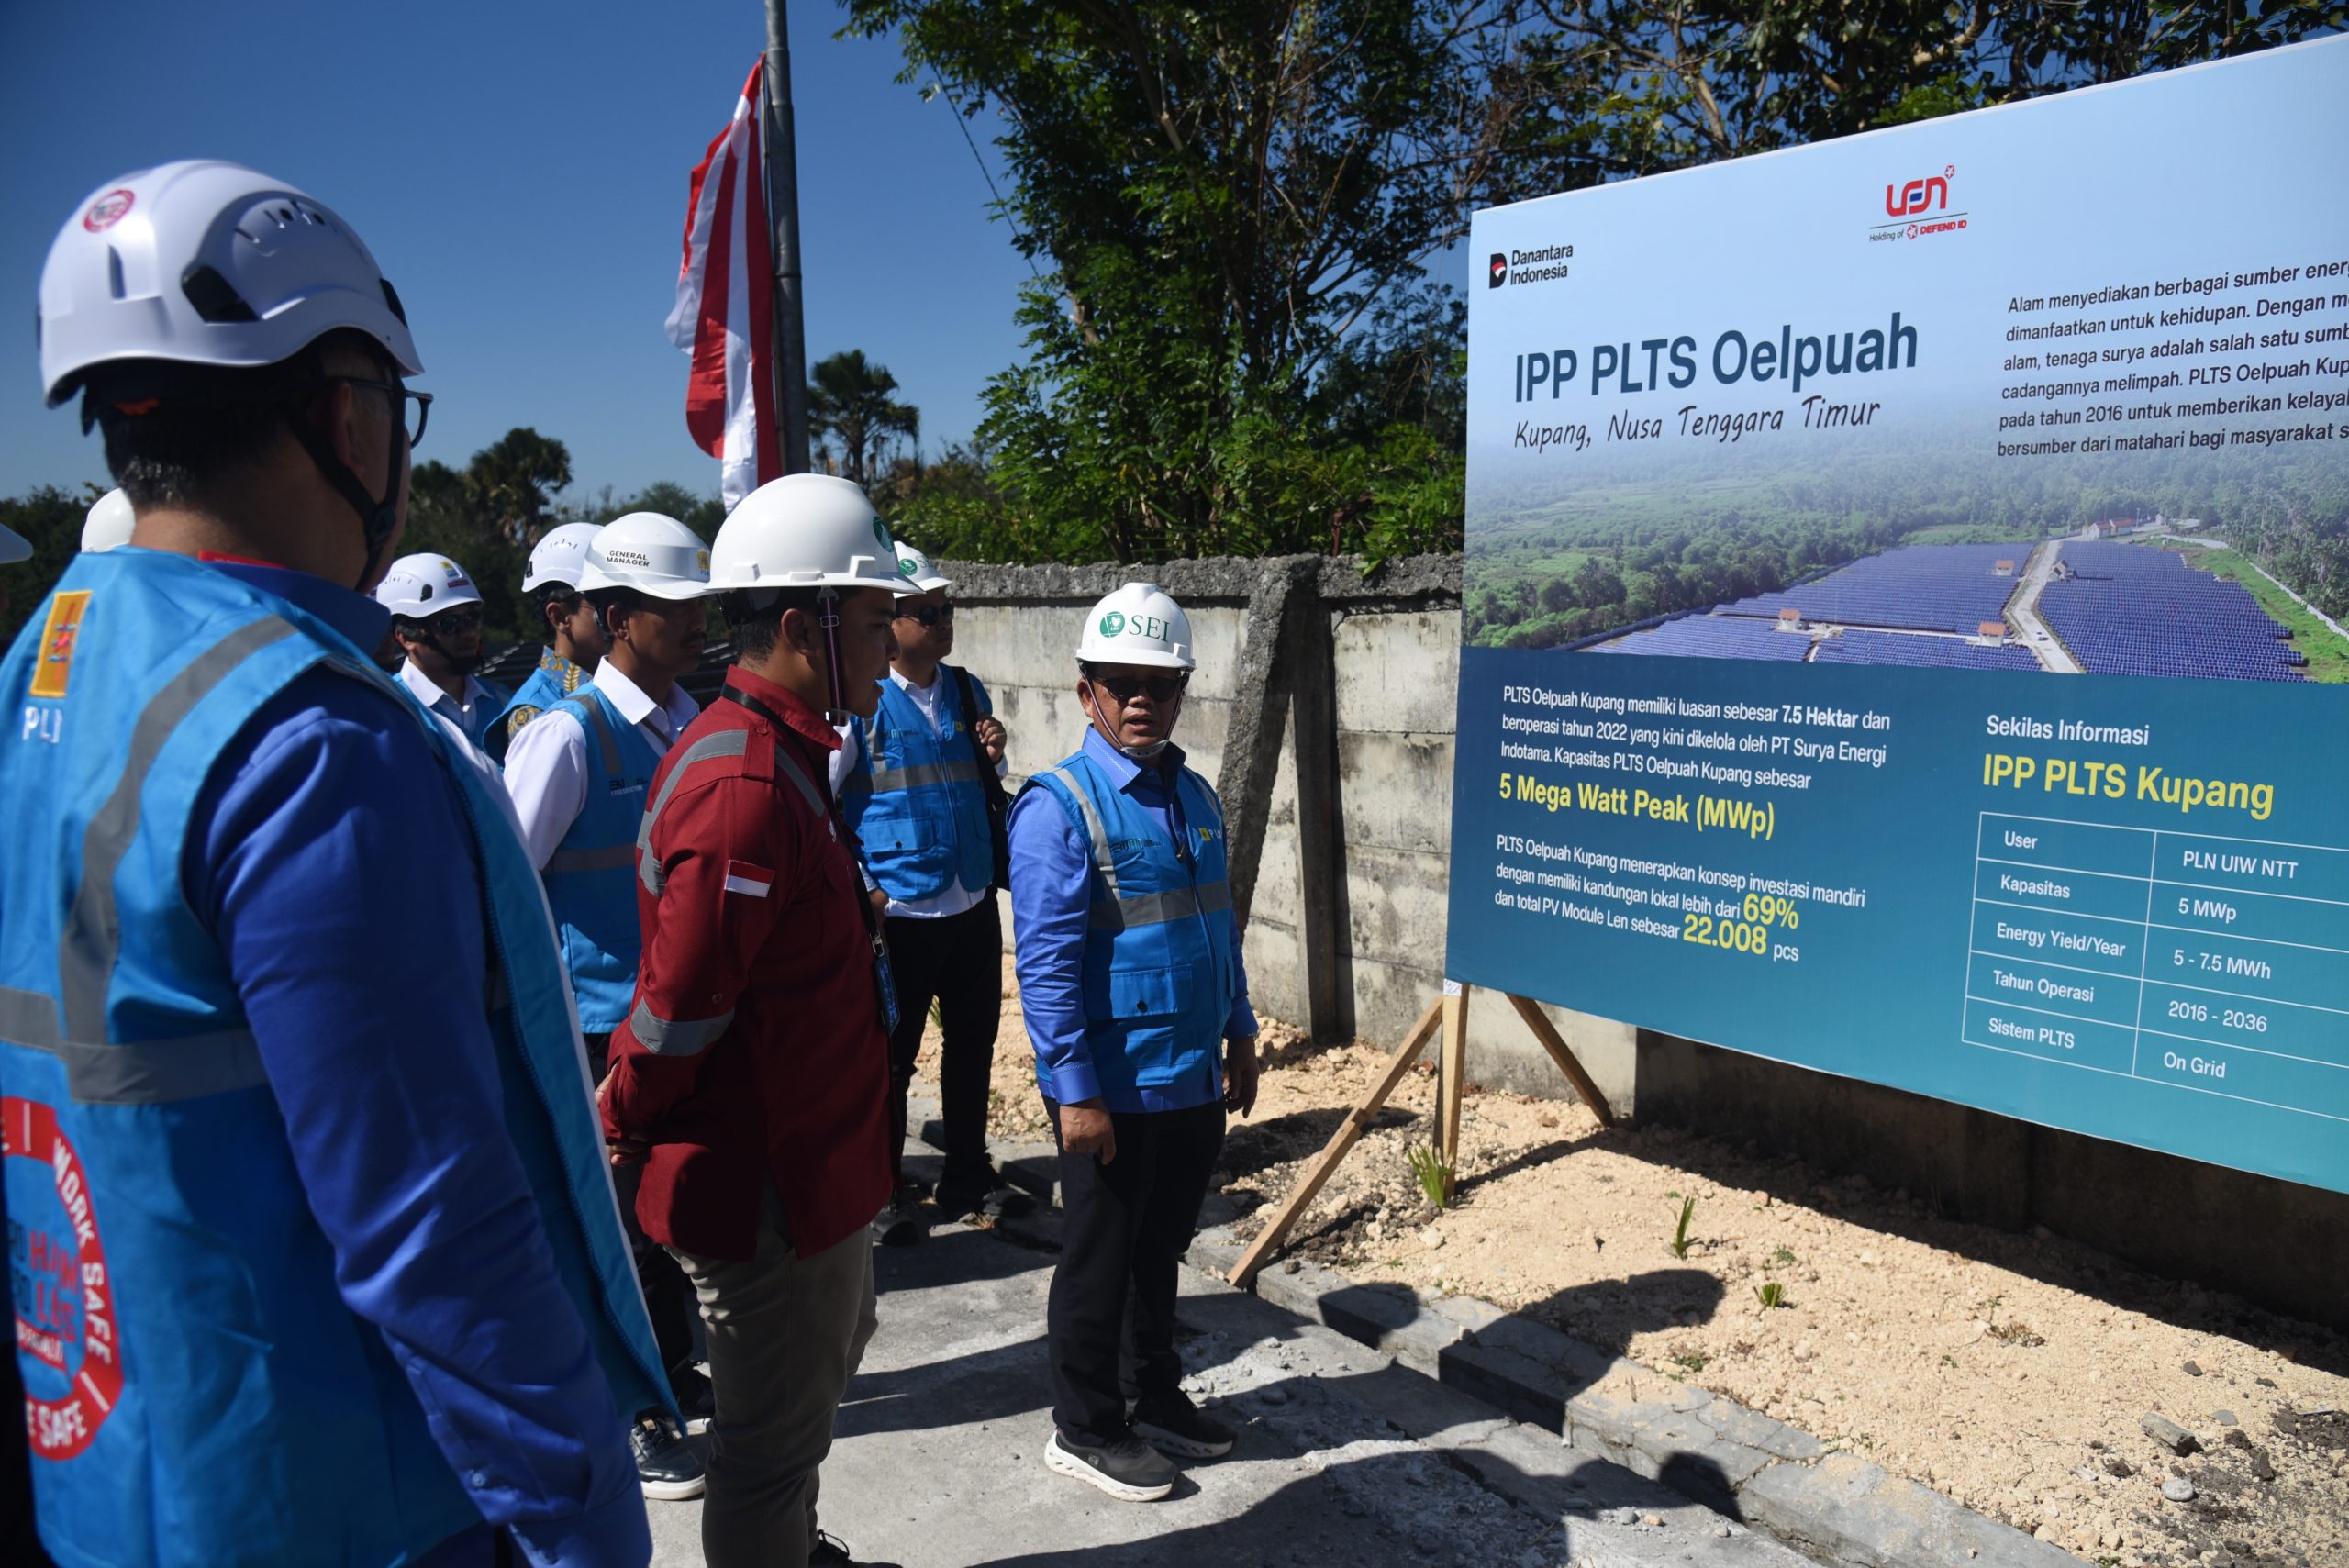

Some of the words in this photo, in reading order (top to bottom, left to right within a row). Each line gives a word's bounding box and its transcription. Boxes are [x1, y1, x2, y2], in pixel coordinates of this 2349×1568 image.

[1869, 231, 1897, 242] Holding
[1896, 228, 1905, 239] of
[1920, 221, 1957, 236] DEFEND
[1957, 219, 1967, 229] ID
[1509, 261, 1568, 285] Indonesia
[1511, 245, 1574, 267] Danantara
[2008, 296, 2044, 314] Alam
[2048, 284, 2150, 310] menyediakan
[2154, 272, 2229, 297] berbagai
[2233, 266, 2300, 288] sumber
[2305, 261, 2349, 280] ener
[2006, 318, 2106, 342] dimanfaatkan
[2110, 311, 2155, 332] untuk
[2159, 306, 2251, 328] kehidupan.
[2256, 296, 2326, 317] Dengan
[2332, 294, 2349, 309] m
[1515, 349, 1577, 403] IPP
[1591, 335, 1697, 396] PLTS
[1712, 311, 1918, 394] Oelpuah
[2003, 354, 2041, 372] alam,
[2045, 350, 2098, 369] tenaga
[2101, 346, 2145, 364] surya
[2150, 337, 2205, 359] adalah
[2209, 332, 2254, 353] salah
[2260, 329, 2299, 349] satu
[2001, 381, 2100, 401] cadangannya
[2104, 370, 2184, 394] melimpah.
[2188, 365, 2232, 386] PLTS
[2236, 359, 2310, 384] Oelpuah
[1514, 420, 1592, 454] Kupang,
[1607, 409, 1663, 442] Nusa
[1678, 405, 1784, 443] Tenggara
[1801, 395, 1881, 428] Timur
[1999, 411, 2035, 432] pada
[2040, 408, 2082, 427] tahun
[2085, 405, 2123, 423] 2016
[2127, 401, 2173, 421] untuk
[2177, 395, 2282, 417] memberikan
[2287, 388, 2349, 412] kelaya
[1998, 438, 2077, 457] bersumber
[2080, 435, 2111, 453] dari
[2114, 430, 2185, 451] matahari
[2188, 428, 2226, 450] bagi
[2230, 422, 2334, 448] masyarakat
[607, 556, 650, 567] MANAGER
[609, 550, 648, 561] GENERAL
[1128, 614, 1171, 642] SEI
[1503, 685, 1531, 704] PLTS
[1531, 687, 1578, 709] Oelpuah
[1580, 691, 1625, 716] Kupang
[1627, 696, 1676, 715] memiliki
[1678, 698, 1720, 718] luasan
[1723, 702, 1779, 722] sebesar
[1781, 704, 1803, 725] 7.5
[1805, 706, 1859, 728] Hektar
[1862, 710, 1891, 730] dan
[1502, 713, 1560, 736] beroperasi
[1561, 718, 1594, 738] tahun
[1596, 721, 1628, 741] 2022
[1629, 728, 1660, 749] yang
[1662, 727, 1685, 746] kini
[1686, 729, 1736, 751] dikelola
[1739, 733, 1768, 753] oleh
[1770, 735, 1791, 755] PT
[1793, 737, 1835, 762] Surya
[1838, 740, 1887, 768] Energi
[1987, 714, 2053, 740] Sekilas
[2058, 718, 2150, 746] Informasi
[1500, 740, 1553, 762] Indotama.
[1554, 746, 1611, 769] Kapasitas
[1613, 751, 1644, 773] PLTS
[1646, 755, 1698, 779] Oelpuah
[1701, 761, 1752, 788] Kupang
[1754, 767, 1812, 789] sebesar
[1983, 753, 2036, 789] IPP
[2044, 759, 2126, 798] PLTS
[2136, 766, 2274, 821] Kupang
[1499, 773, 1511, 799] 5
[1517, 774, 1572, 813] Mega
[1577, 782, 1629, 816] Watt
[1633, 789, 1689, 823] Peak
[1696, 794, 1775, 841] (MWp)
[2004, 830, 2038, 850] User
[1497, 834, 1524, 854] PLTS
[1525, 839, 1572, 862] Oelpuah
[1573, 846, 1618, 873] Kupang
[1620, 858, 1696, 882] menerapkan
[1698, 865, 1747, 893] konsep
[1749, 873, 1810, 900] investasi
[1812, 886, 1866, 907] mandiri
[2183, 851, 2217, 871] PLN
[2221, 854, 2258, 874] UIW
[2261, 859, 2299, 879] NTT
[1495, 862, 1535, 885] dengan
[1537, 873, 1582, 892] memiliki
[1583, 876, 1648, 906] kandungan
[1650, 887, 1680, 909] lokal
[1682, 893, 1712, 915] lebih
[1714, 899, 1741, 920] dari
[1743, 893, 1799, 929] 69%
[2000, 874, 2071, 898] Kapasitas
[1494, 889, 1515, 907] dan
[1516, 893, 1541, 913] total
[1542, 896, 1560, 916] PV
[1561, 900, 1605, 925] Module
[1607, 909, 1629, 929] Len
[1631, 917, 1681, 939] sebesar
[1683, 913, 1767, 955] 22.008
[1773, 944, 1799, 962] pcs
[2178, 897, 2189, 915] 5
[2193, 899, 2237, 924] MWp
[1996, 922, 2047, 948] Energy
[2050, 929, 2126, 957] Yield/Year
[2174, 949, 2185, 966] 5
[2199, 952, 2222, 972] 7.5
[2226, 957, 2271, 980] MWh
[1993, 970, 2034, 992] Tahun
[2037, 977, 2095, 1003] Operasi
[1988, 1018, 2035, 1041] Sistem
[2038, 1027, 2075, 1049] PLTS
[2168, 1000, 2208, 1022] 2016
[2222, 1009, 2267, 1032] 2036
[2164, 1051, 2187, 1071] On
[2190, 1056, 2226, 1079] Grid
[82, 1262, 113, 1365] SAFE
